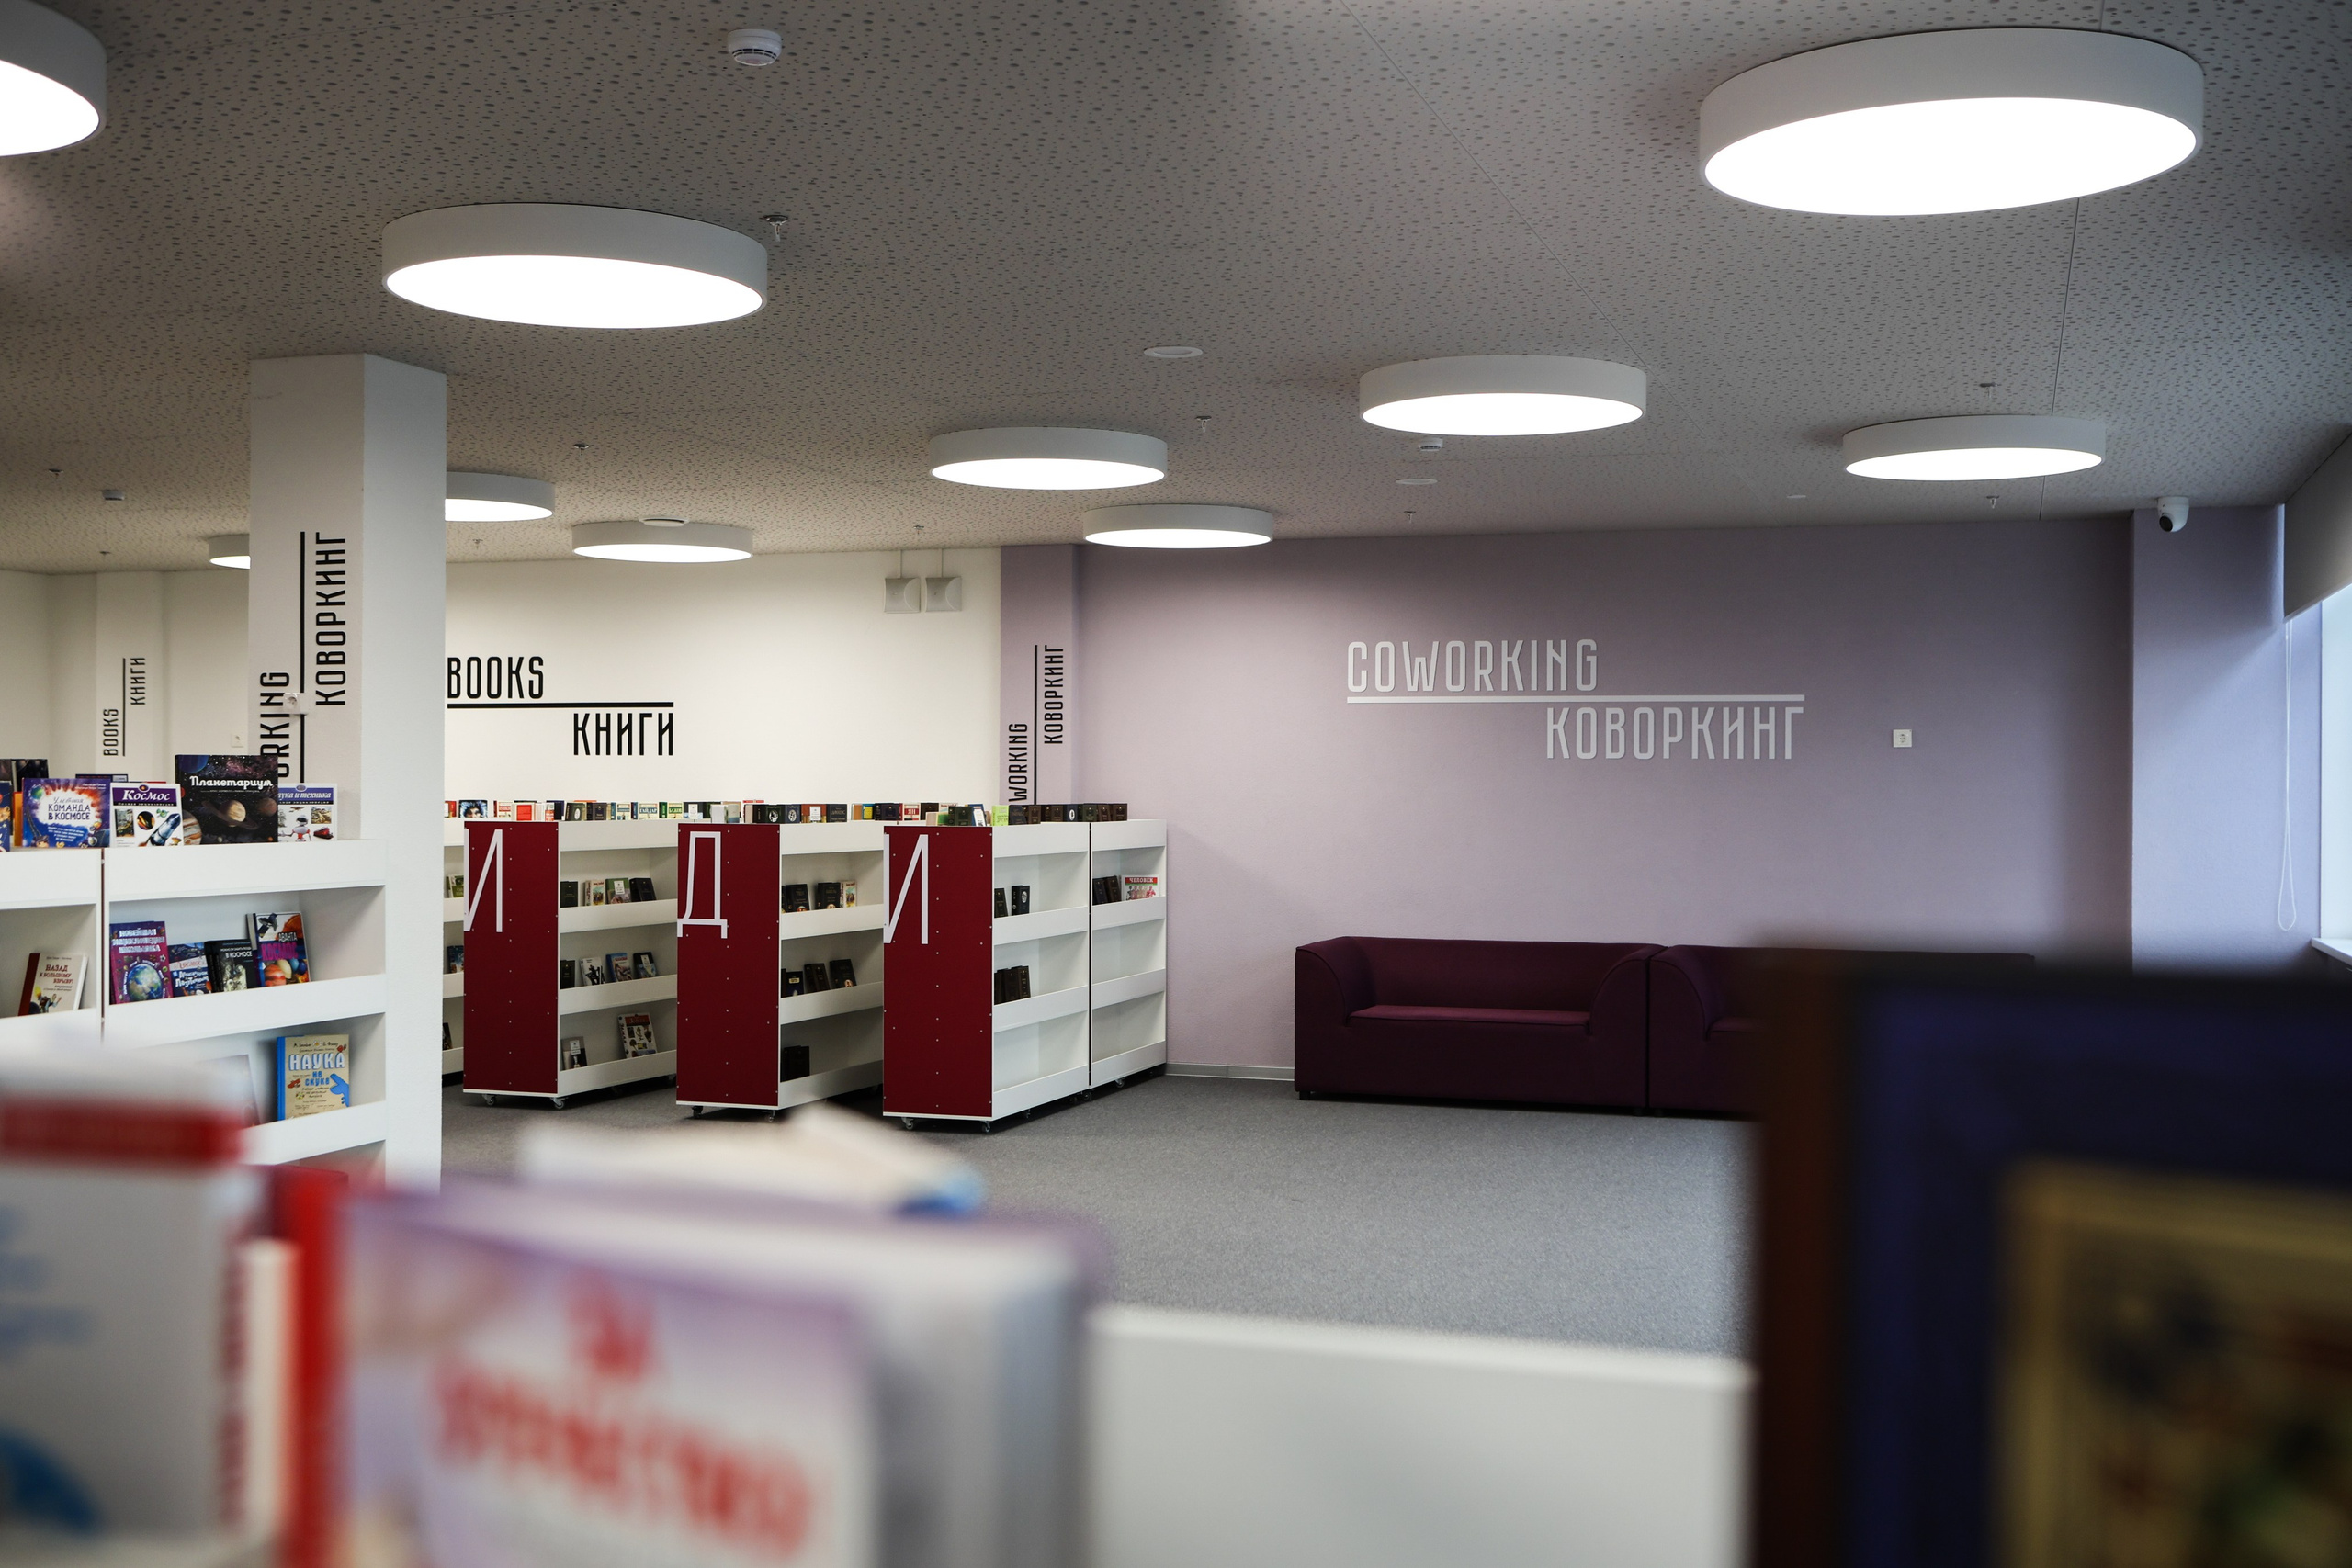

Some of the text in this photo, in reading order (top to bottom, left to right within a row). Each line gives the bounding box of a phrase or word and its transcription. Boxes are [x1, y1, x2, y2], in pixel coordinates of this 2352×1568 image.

[315, 531, 346, 705] КОВОРКИНГ
[130, 656, 146, 705] КНИГИ
[447, 655, 544, 699] BOOKS
[1346, 638, 1599, 693] COWORKING
[1044, 644, 1064, 744] КОВОРКИНГ
[103, 708, 119, 757] BOOKS
[573, 712, 673, 756] КНИГИ
[1545, 705, 1804, 760] КОВОРКИНГ
[122, 789, 171, 801] Космос
[189, 775, 274, 790] Планетариум
[48, 804, 91, 812] КОМАНДА
[48, 812, 91, 820] В КОСМОСЕ
[676, 830, 728, 939] Д
[230, 950, 253, 958] КОСМОСЕ
[278, 931, 298, 942] АВАНТА
[45, 964, 69, 972] НАЗАД
[288, 1052, 345, 1071] НАУКА
